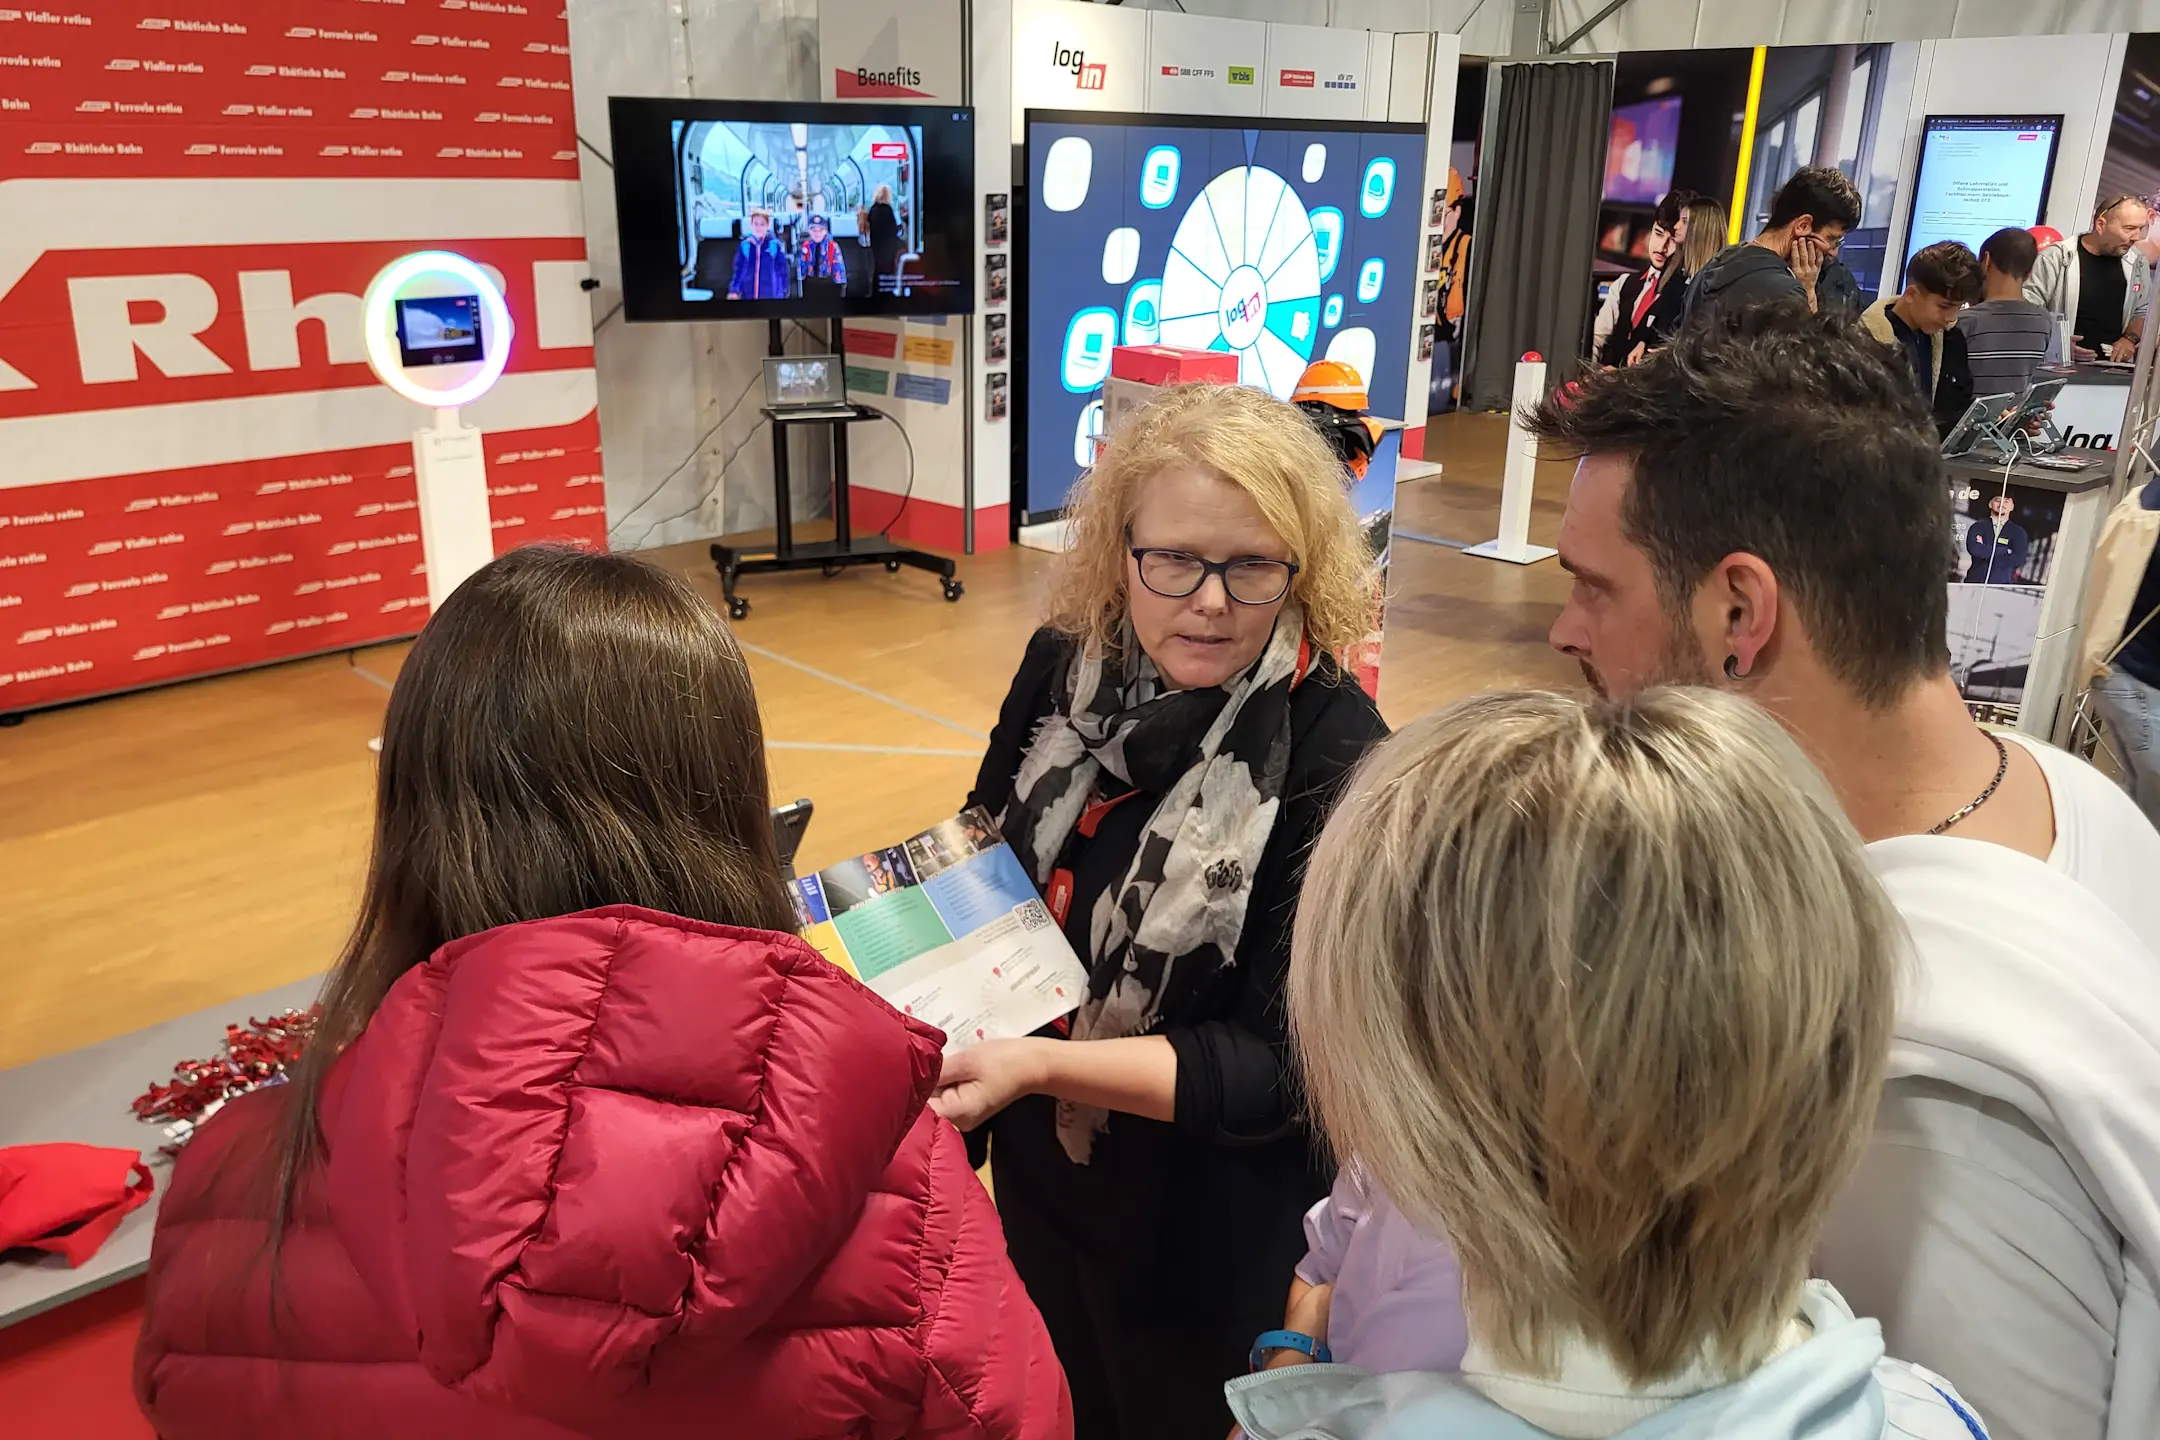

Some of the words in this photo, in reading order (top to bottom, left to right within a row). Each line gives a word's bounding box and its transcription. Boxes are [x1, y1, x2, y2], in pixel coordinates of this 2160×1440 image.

[222, 23, 247, 33] Bahn
[1053, 41, 1084, 75] log
[1080, 63, 1103, 88] in
[858, 66, 921, 87] Benefits
[1958, 486, 1980, 500] de
